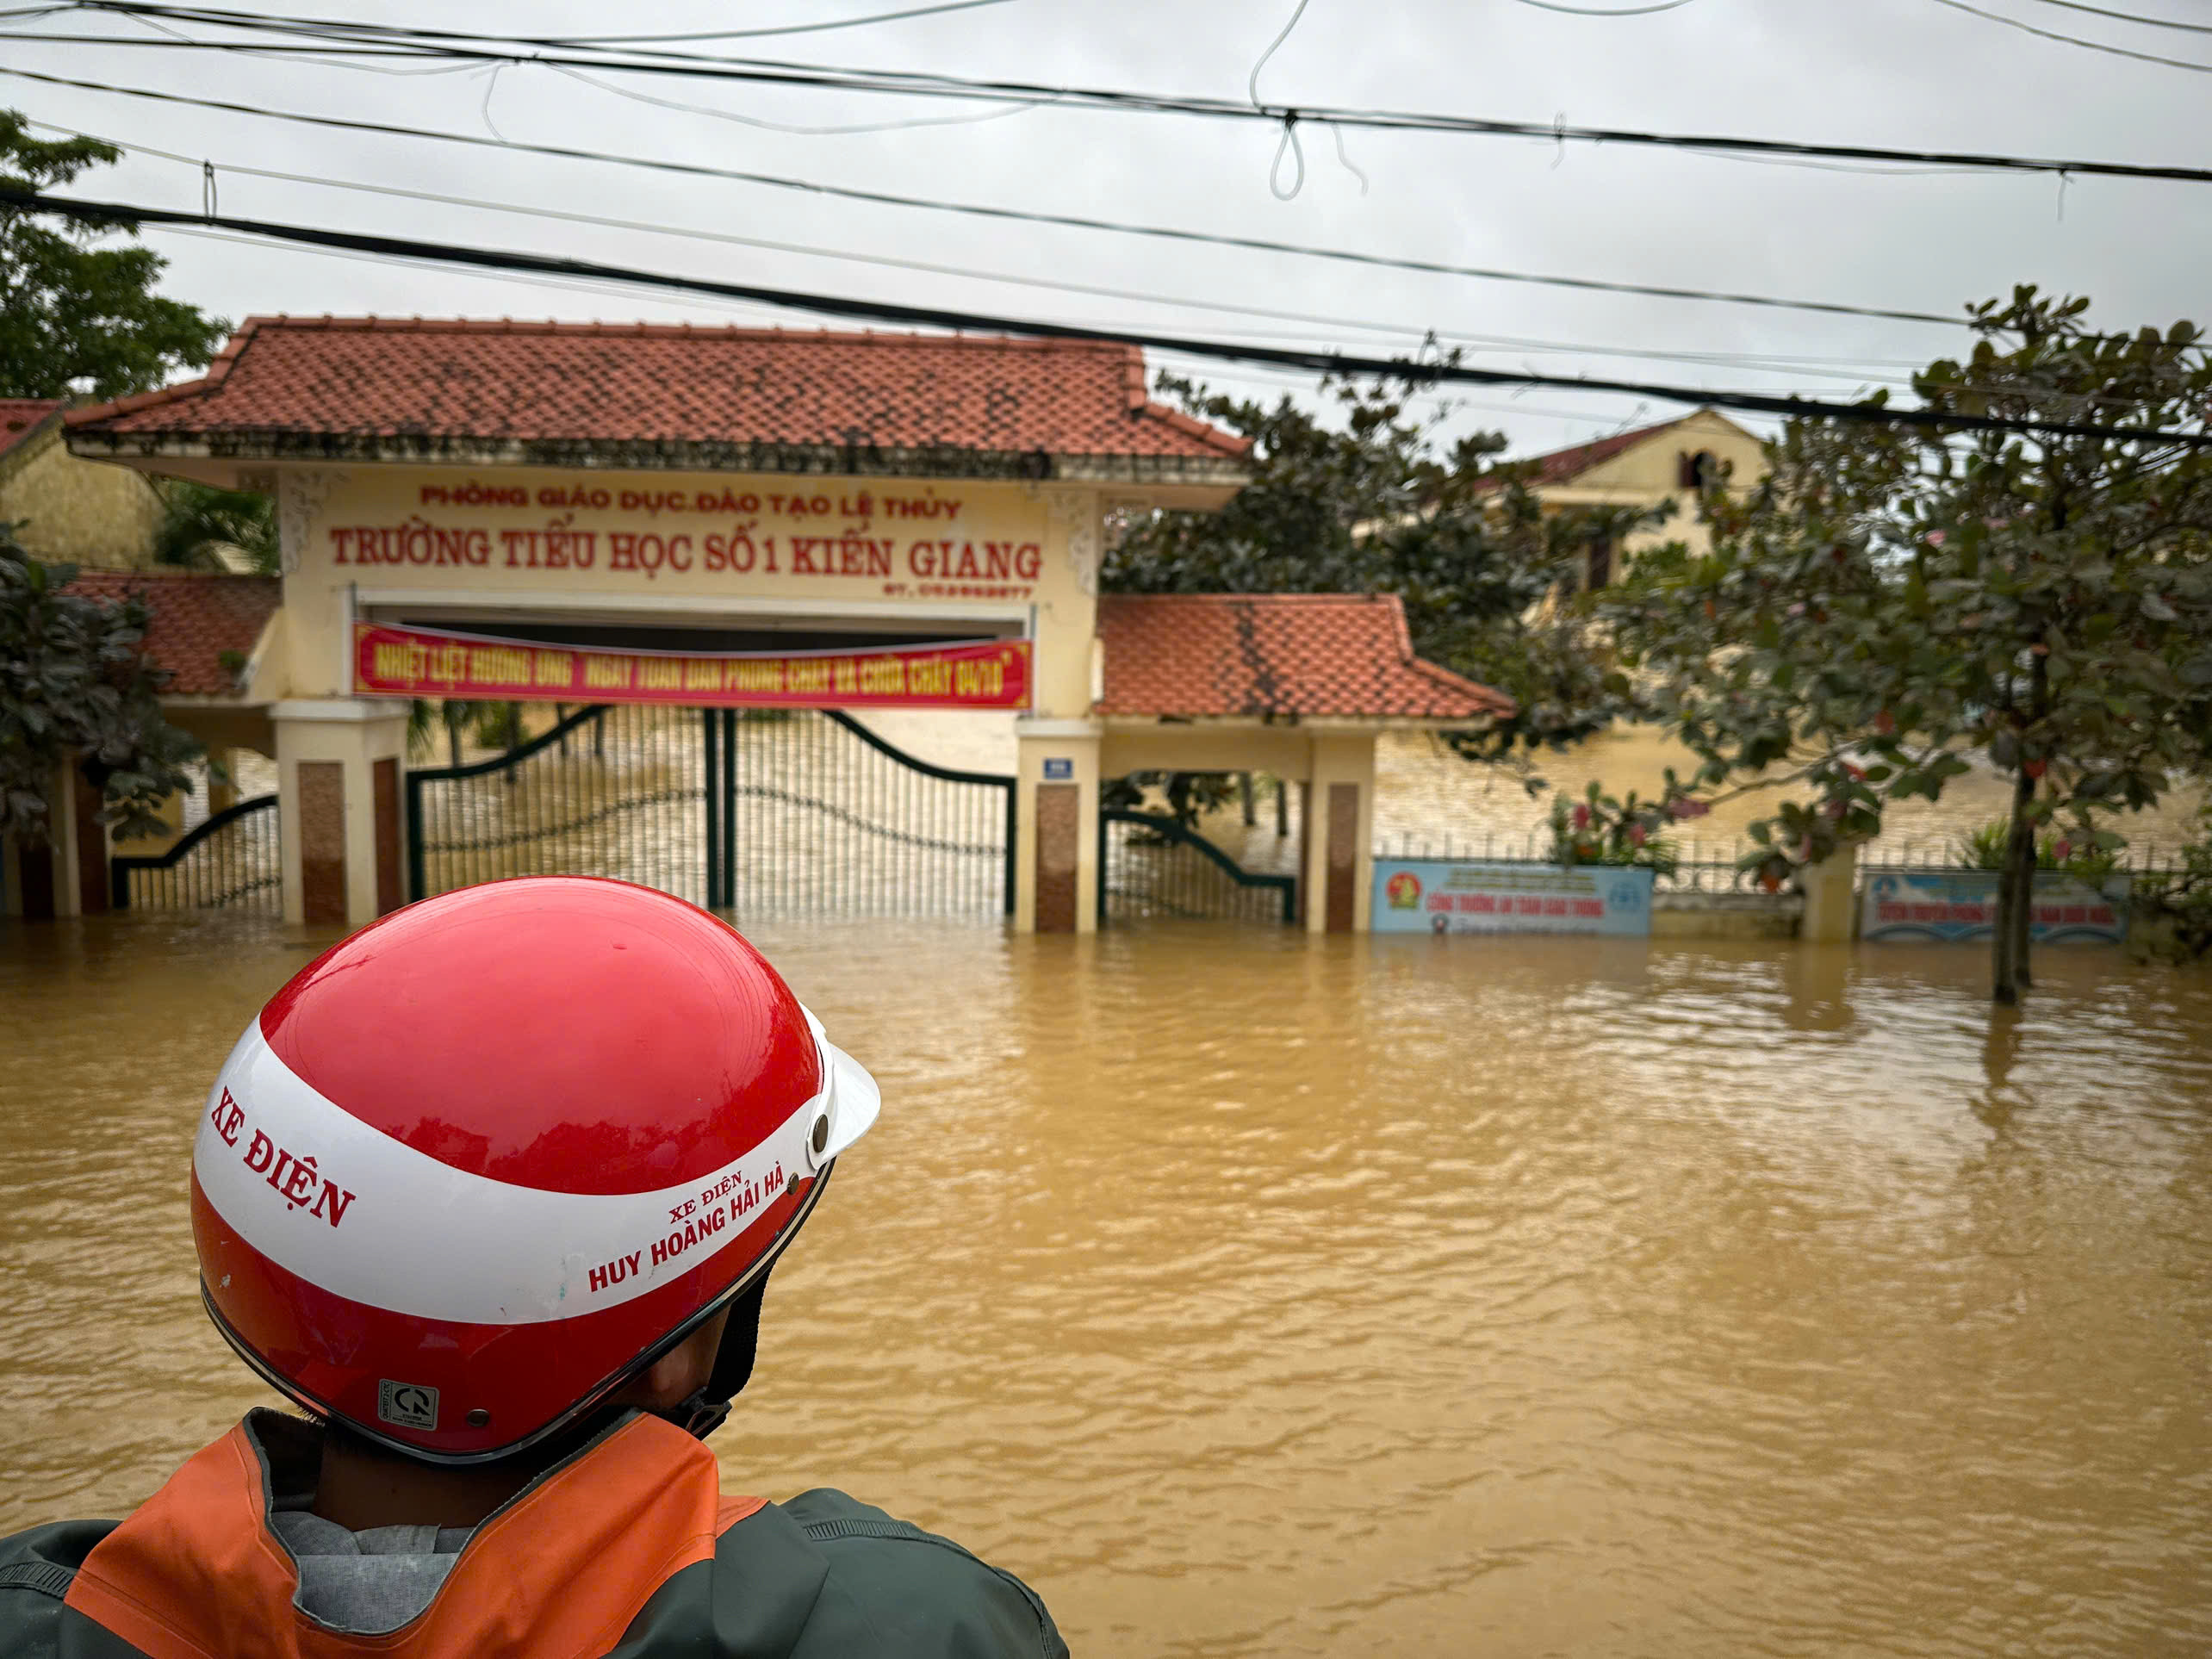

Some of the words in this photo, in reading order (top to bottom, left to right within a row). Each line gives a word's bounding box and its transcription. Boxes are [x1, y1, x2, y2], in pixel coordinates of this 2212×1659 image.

[419, 480, 528, 507] PHÒNG
[537, 481, 611, 510] GIÁO
[765, 493, 831, 521] TẠO
[840, 488, 873, 522] LỆ
[883, 486, 962, 520] THỦY
[330, 514, 492, 566] TRƯỜNG
[500, 512, 597, 569] TIỂU
[608, 531, 692, 579] HỌC
[704, 520, 758, 573] SỐ
[908, 540, 1043, 581] GIANG
[211, 1084, 245, 1147] XE
[243, 1128, 357, 1227] ĐIỆN
[588, 1251, 641, 1292] HUY
[650, 1206, 725, 1266] HOÀNG
[730, 1179, 760, 1221] HẢI
[764, 1160, 784, 1196] HÀ
[668, 1199, 696, 1224] XE
[700, 1171, 742, 1206] ĐIỆN
